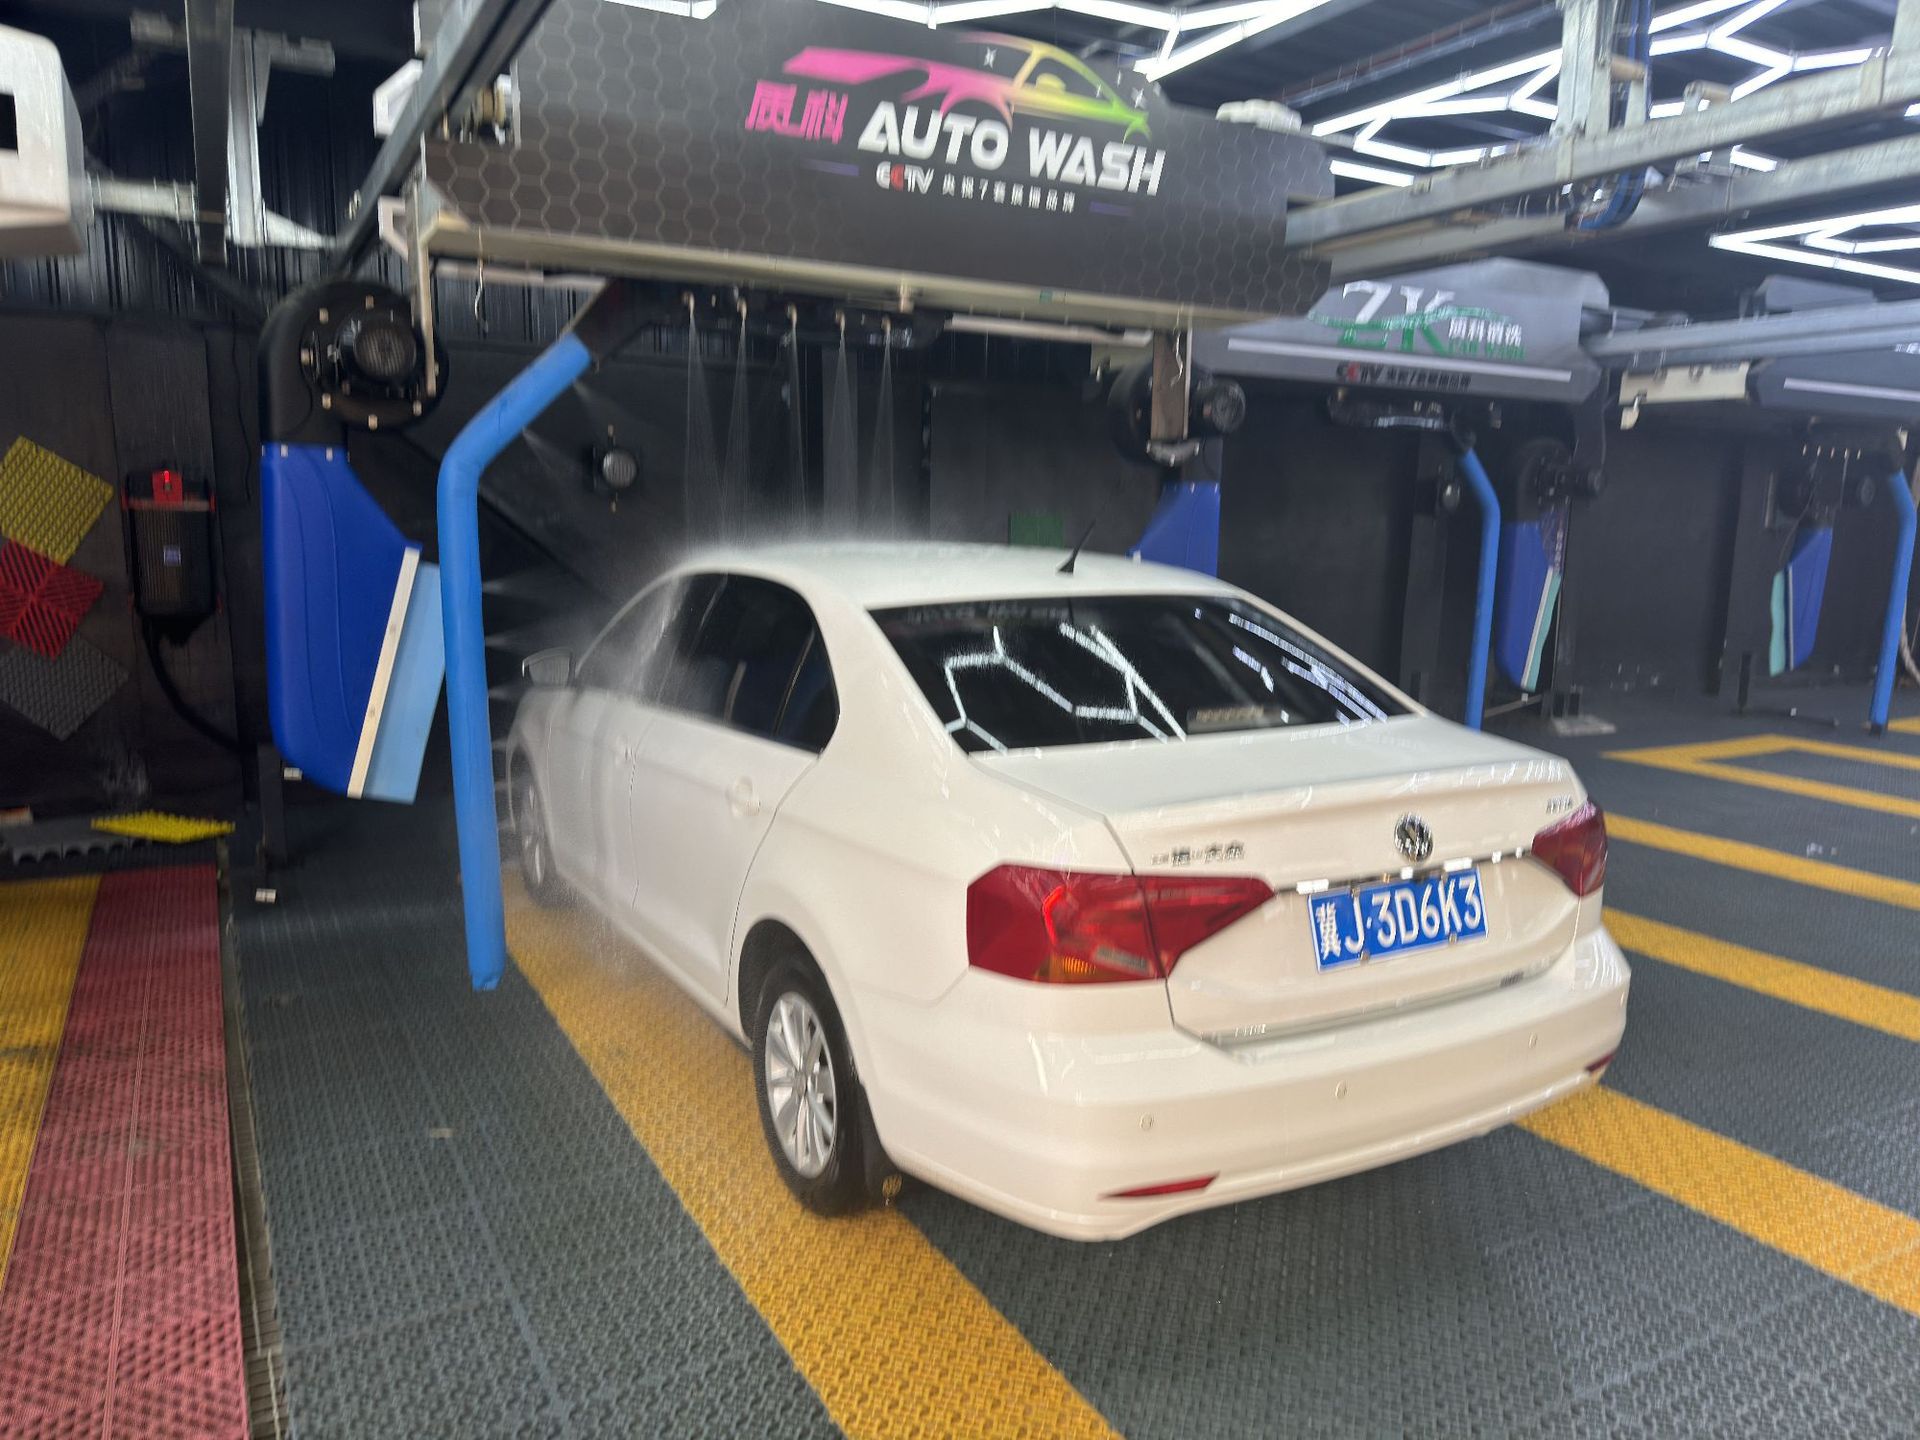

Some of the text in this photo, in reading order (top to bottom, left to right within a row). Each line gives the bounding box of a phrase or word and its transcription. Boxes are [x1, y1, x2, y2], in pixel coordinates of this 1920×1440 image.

[858, 100, 1167, 196] AUTO WASH
[875, 160, 935, 195] CCTV
